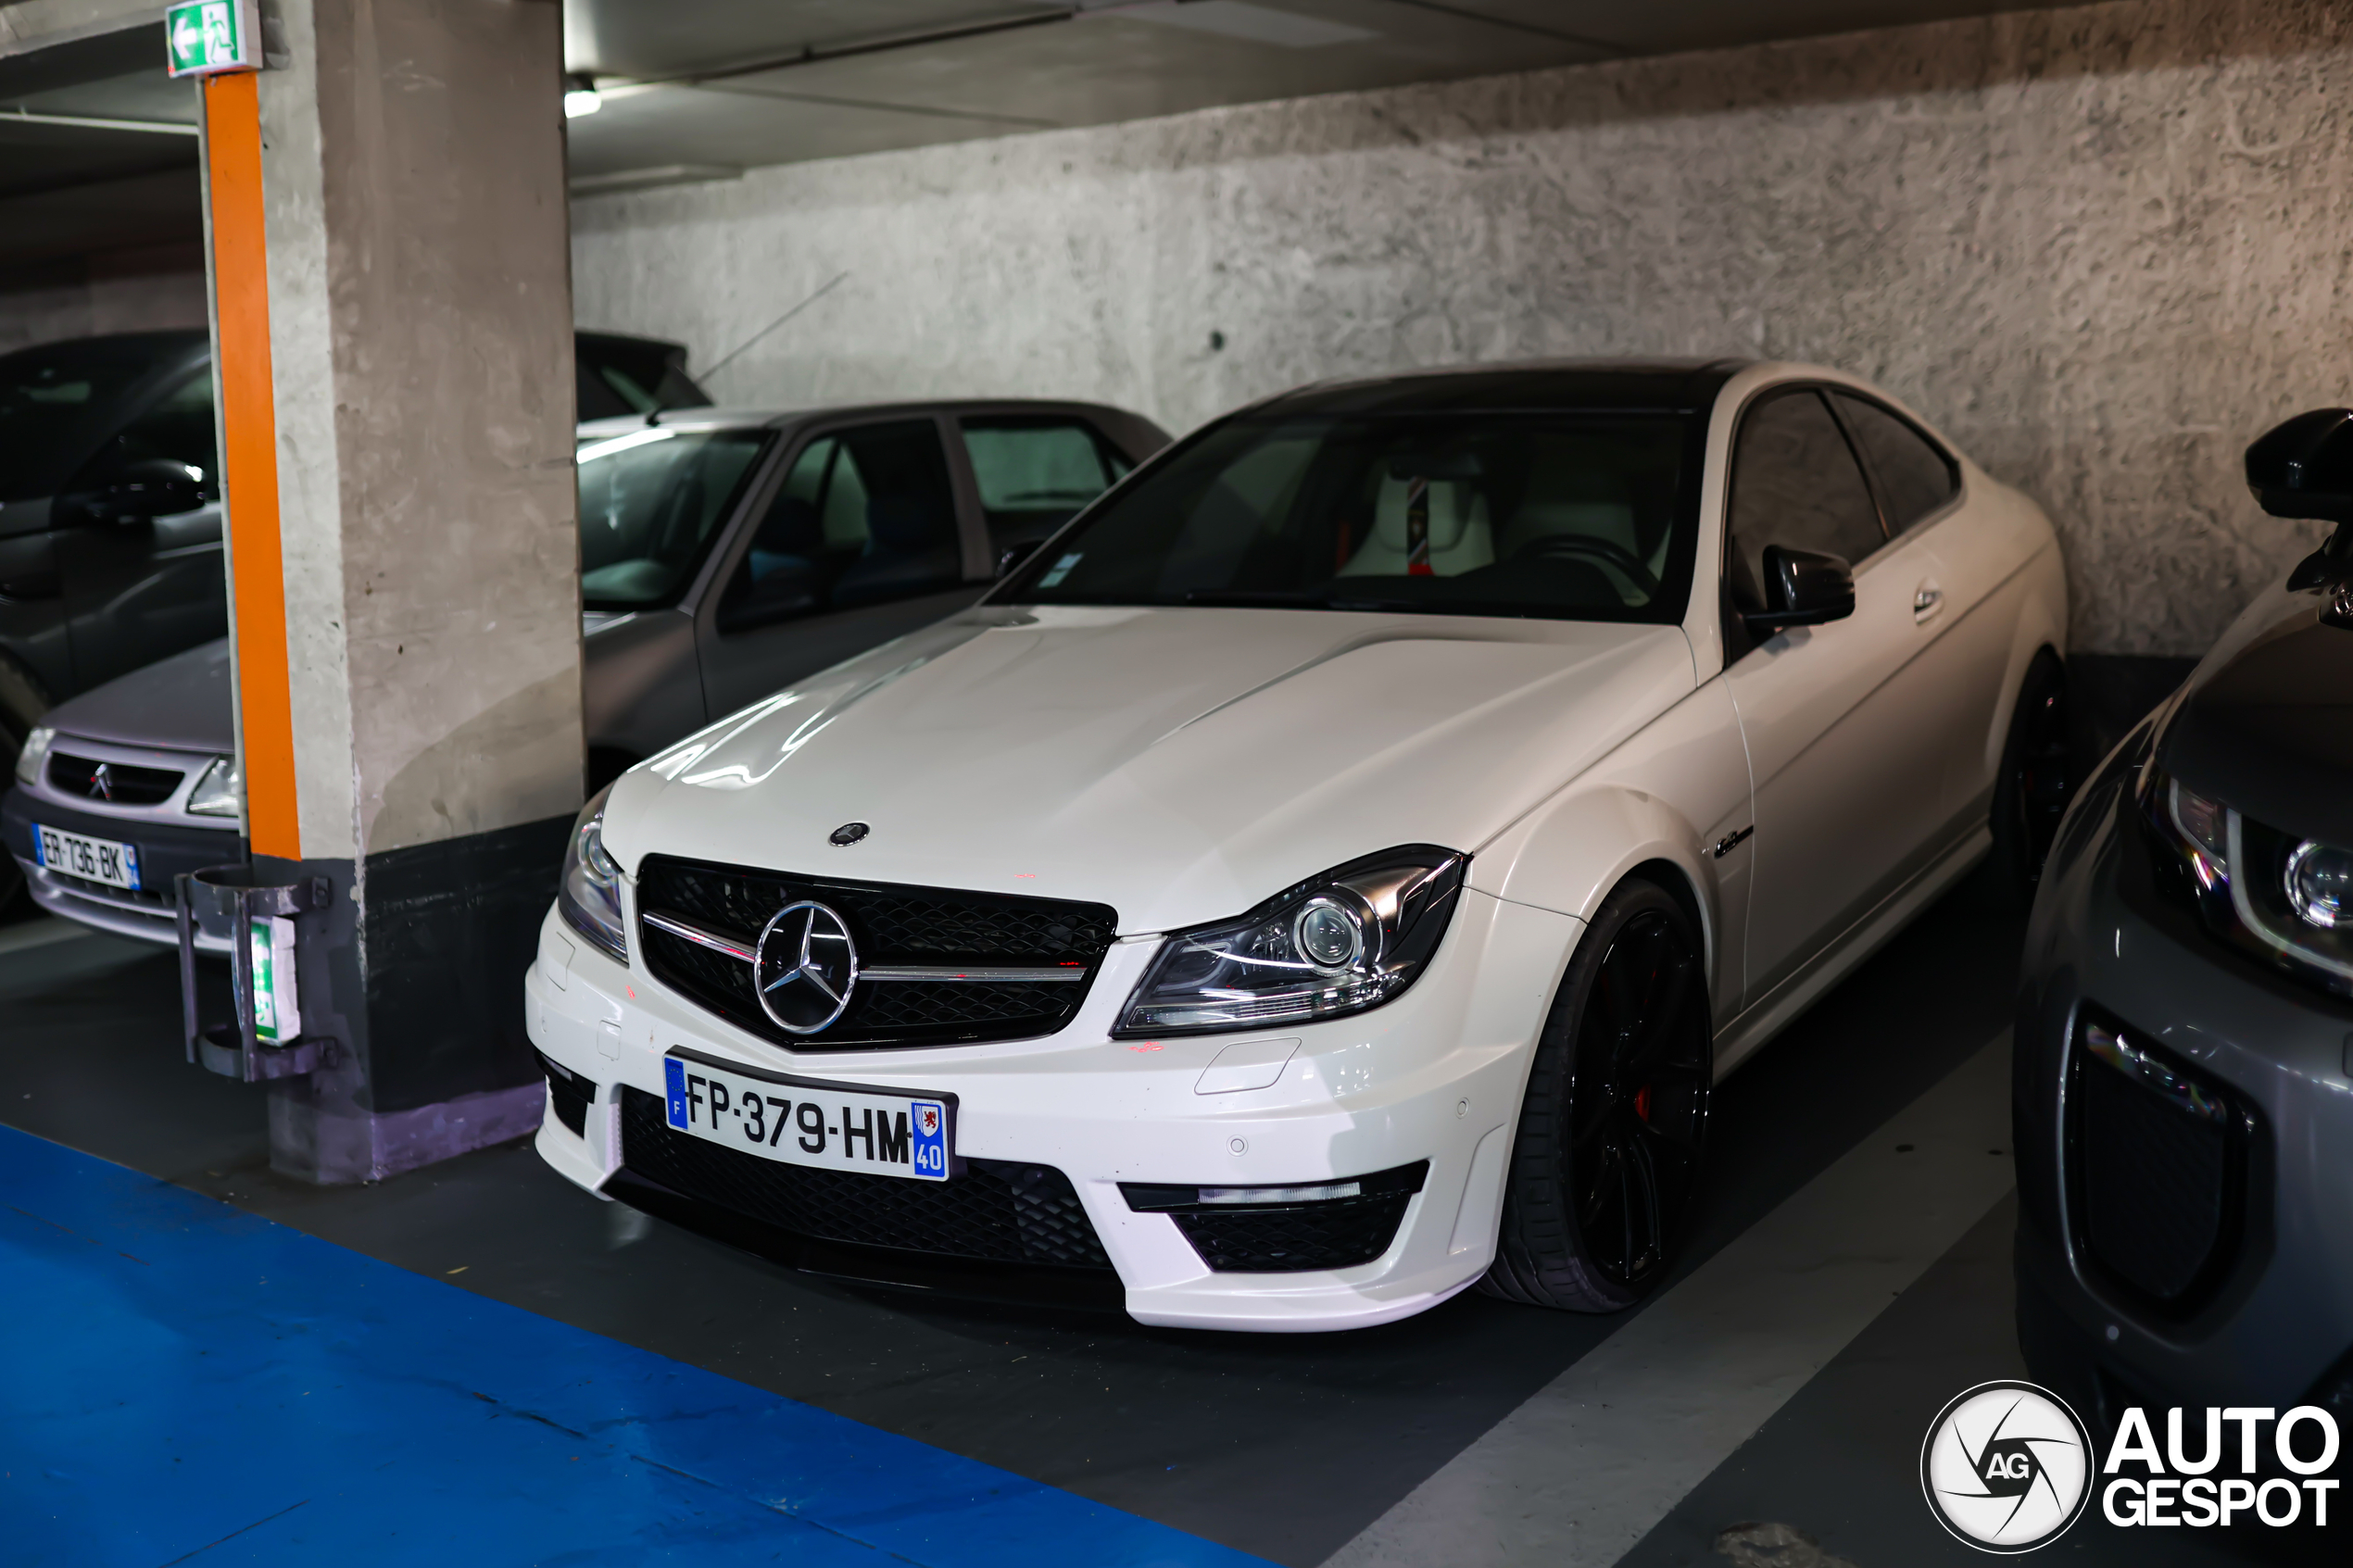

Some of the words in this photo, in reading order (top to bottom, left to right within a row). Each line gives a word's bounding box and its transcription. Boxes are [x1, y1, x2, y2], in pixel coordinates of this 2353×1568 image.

[673, 1100, 680, 1115] F
[687, 1073, 910, 1164] FP-379-HM
[916, 1144, 942, 1171] 40
